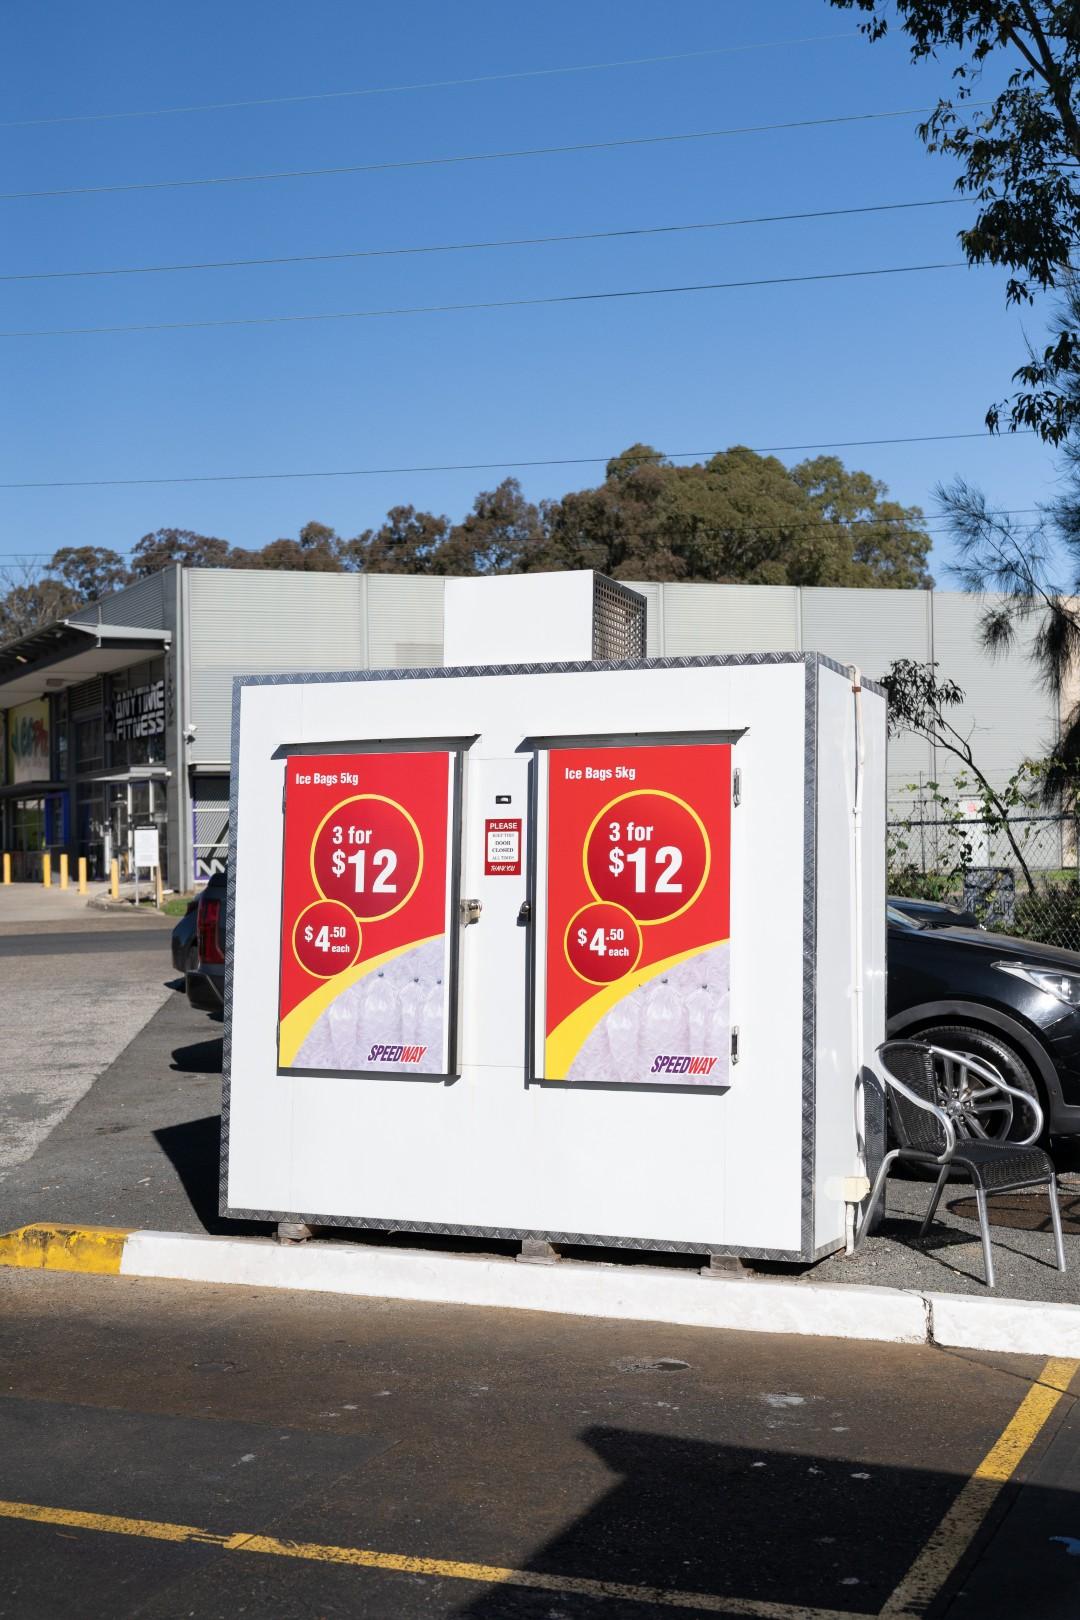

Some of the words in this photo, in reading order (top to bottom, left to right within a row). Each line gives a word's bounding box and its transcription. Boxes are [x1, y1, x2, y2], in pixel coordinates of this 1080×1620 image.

[115, 680, 164, 720] ANYTIME
[116, 710, 165, 741] FITNESS
[295, 773, 311, 784] Ice
[313, 773, 338, 785] Bags
[340, 773, 359, 786] 5kg
[565, 767, 582, 779] Ice
[585, 767, 612, 781] Bags
[615, 767, 636, 780] 5kg
[332, 826, 343, 844] 3
[347, 825, 373, 844] for
[609, 822, 620, 841] 3
[626, 821, 654, 841] for
[331, 848, 398, 894] $12
[608, 845, 683, 893] $12
[331, 944, 350, 953] each
[608, 946, 630, 957] each
[367, 1044, 428, 1063] SPEEDWAY
[650, 1055, 718, 1075] SPEEDWAY
